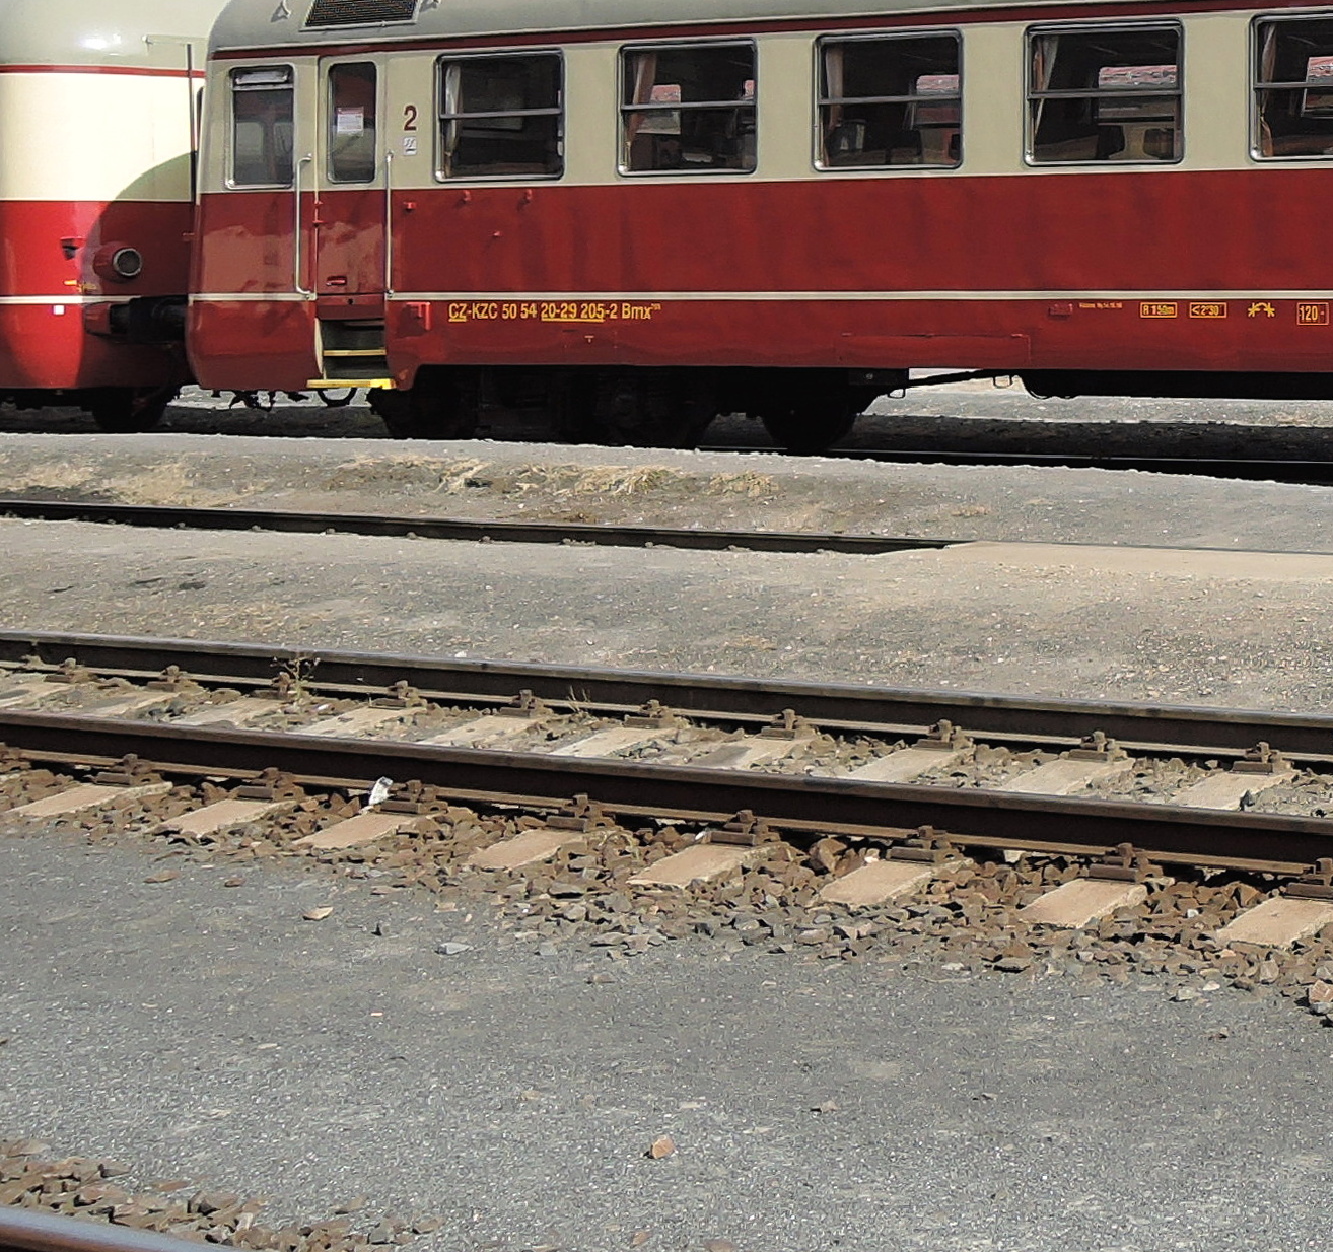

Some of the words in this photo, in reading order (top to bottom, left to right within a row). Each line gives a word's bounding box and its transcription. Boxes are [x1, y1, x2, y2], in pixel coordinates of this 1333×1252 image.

[403, 105, 417, 131] 2
[448, 303, 498, 321] CZ-KZC
[502, 303, 517, 319] 50
[520, 303, 537, 319] 54
[541, 303, 577, 321] 20-29
[581, 303, 618, 321] 205-2
